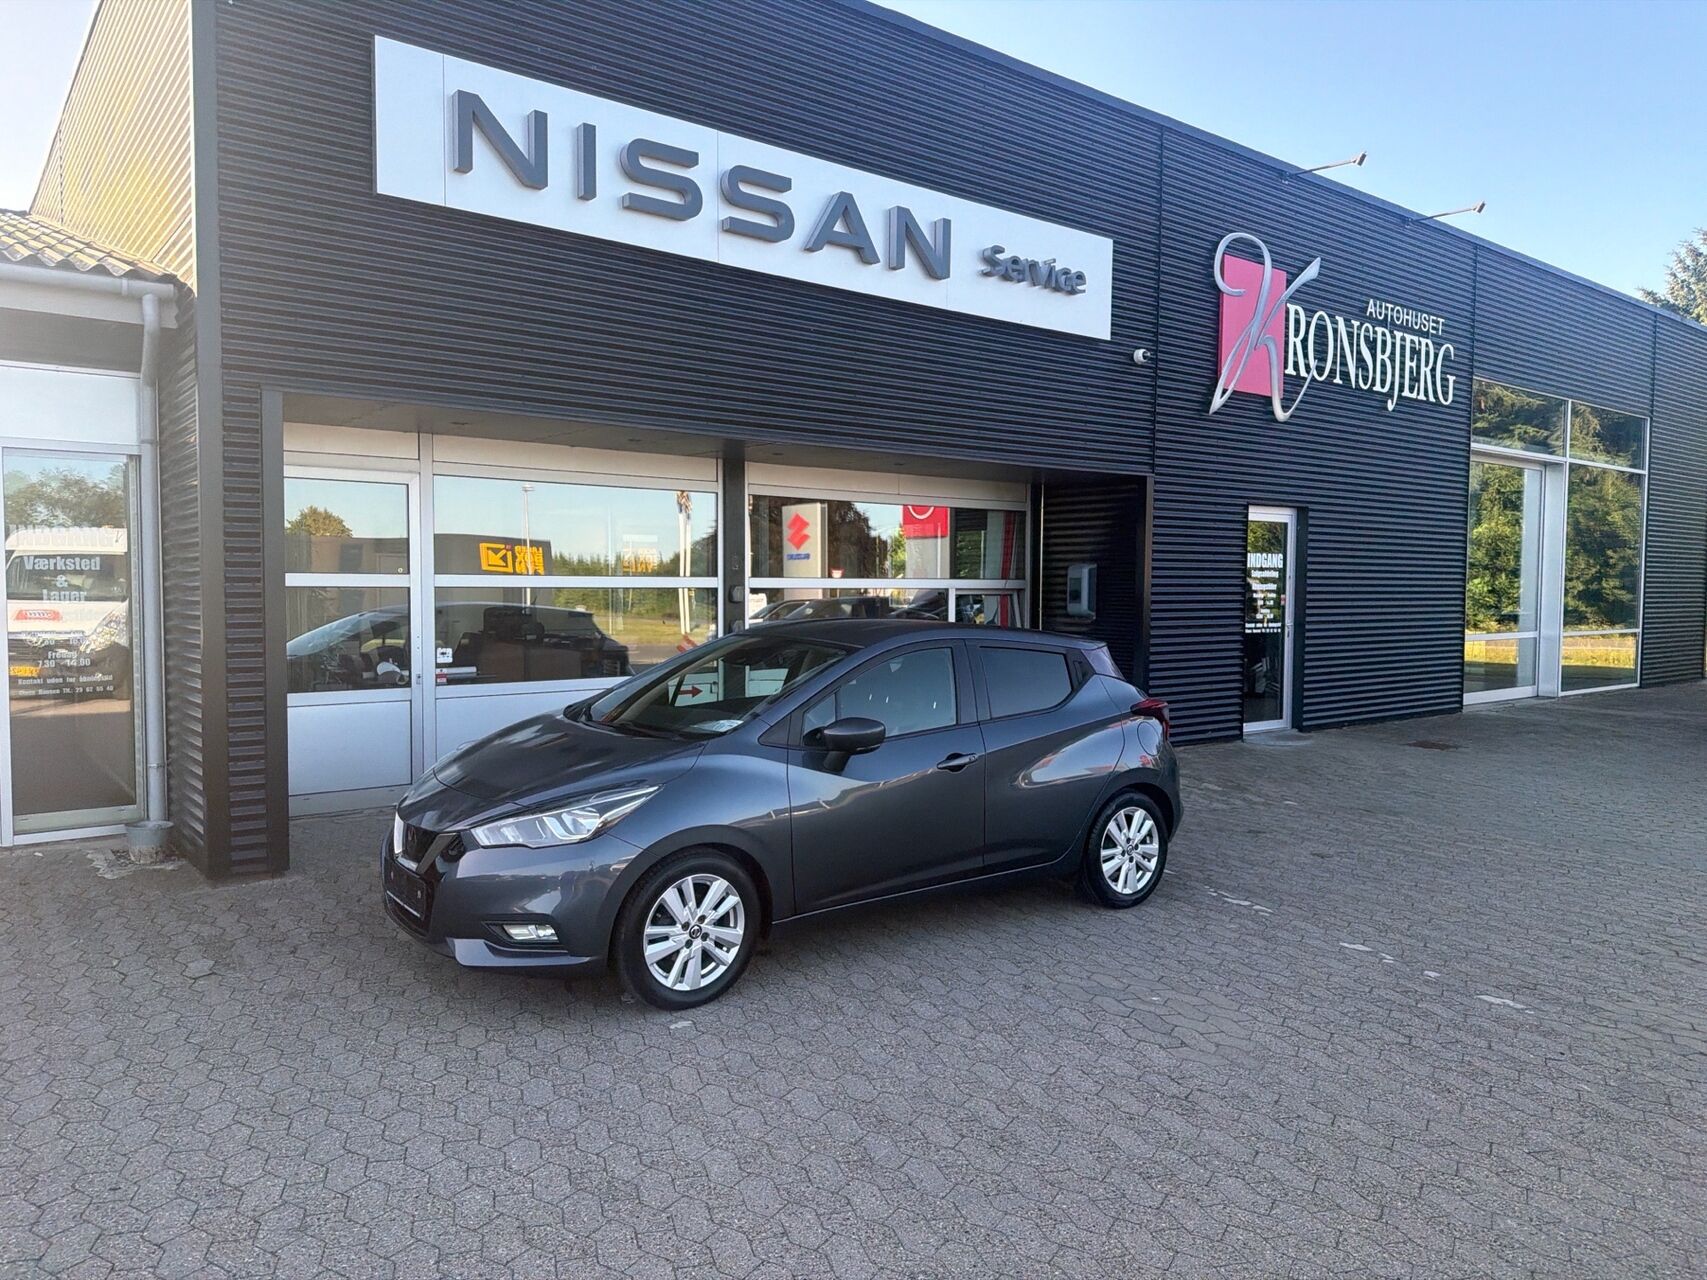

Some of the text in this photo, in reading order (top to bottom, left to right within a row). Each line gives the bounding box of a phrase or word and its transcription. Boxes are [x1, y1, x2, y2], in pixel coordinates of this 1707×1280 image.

[452, 90, 1087, 296] NISSAN Service
[1366, 298, 1445, 336] AUTOHUSET
[23, 555, 101, 570] Værksted
[1247, 552, 1284, 569] INDGANG
[55, 574, 69, 588] &
[42, 588, 87, 604] Lager
